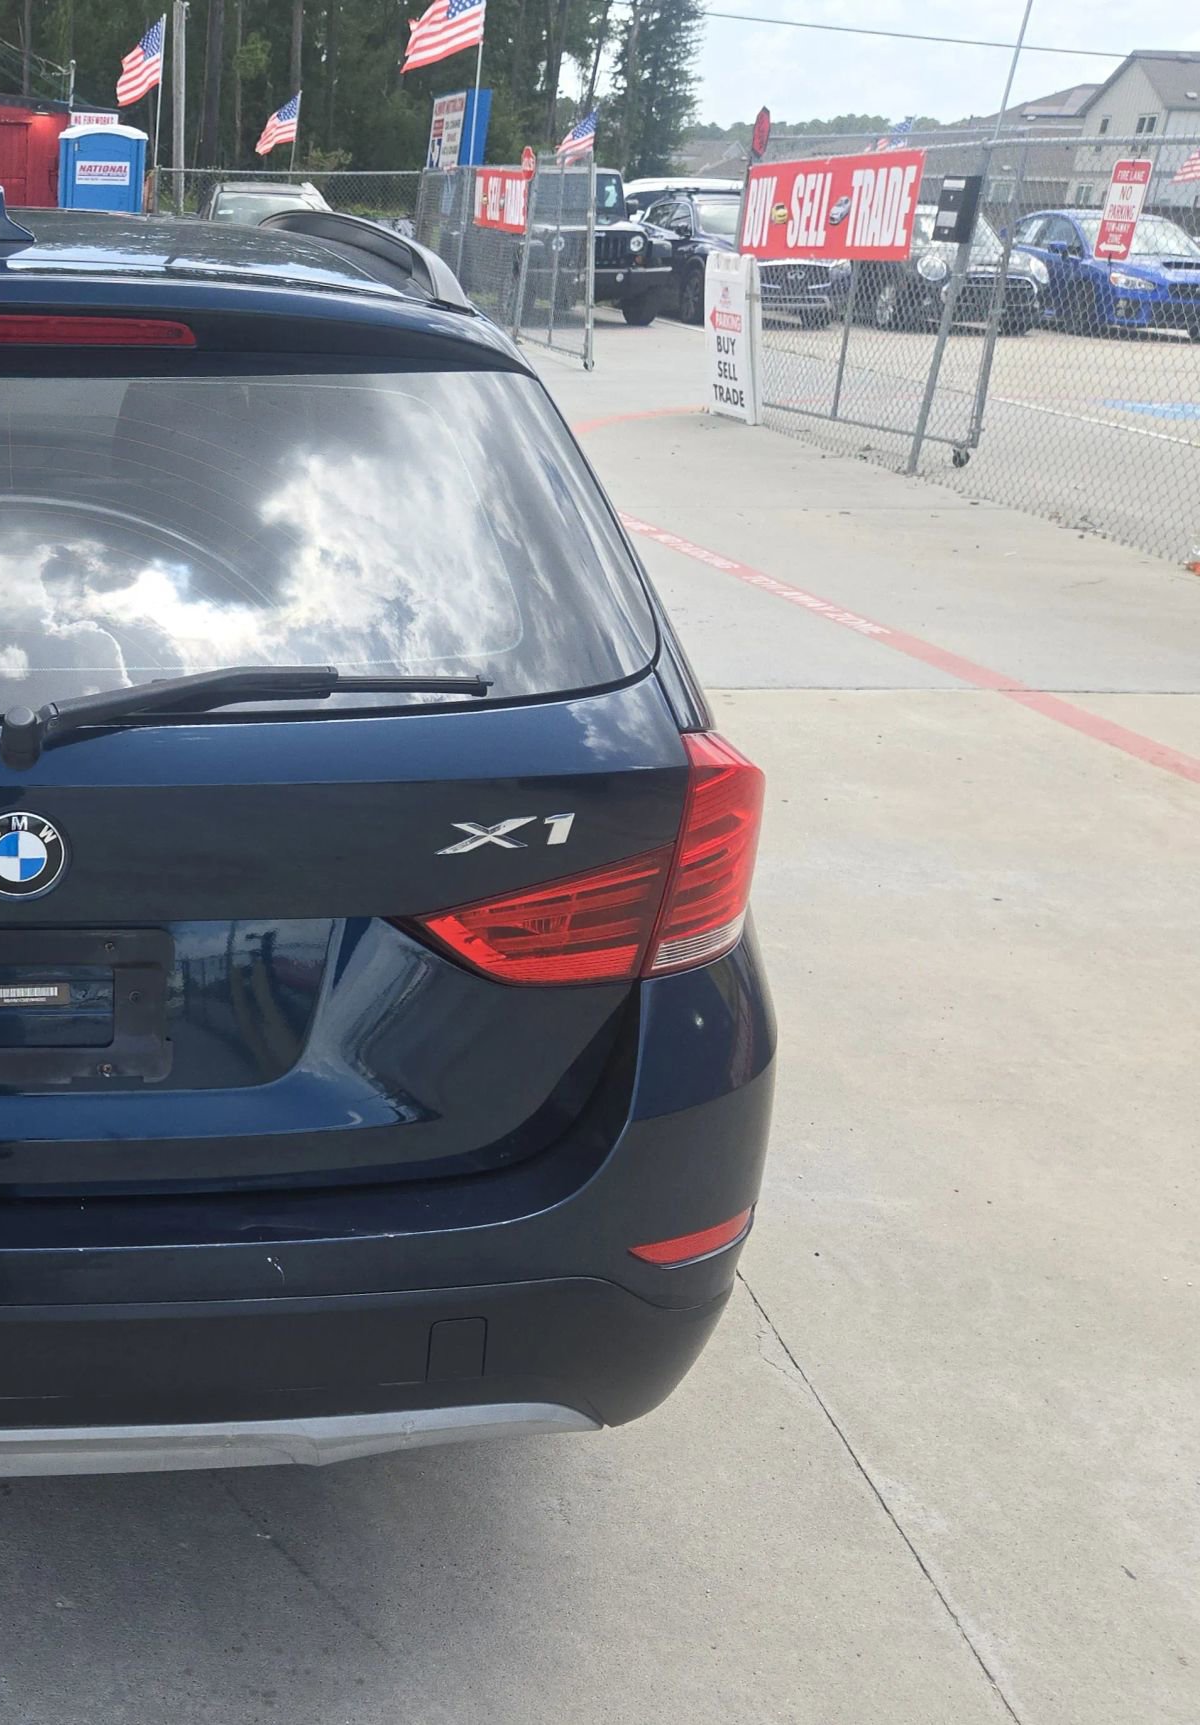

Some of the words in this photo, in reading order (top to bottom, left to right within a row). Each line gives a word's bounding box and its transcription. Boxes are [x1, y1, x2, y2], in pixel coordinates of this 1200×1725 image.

[79, 164, 128, 173] NATIONAL
[1117, 170, 1129, 181] FIRE
[1129, 170, 1145, 182] LANE
[1120, 186, 1133, 201] NO
[742, 177, 777, 248] BUY
[786, 172, 833, 248] SELL
[845, 165, 918, 248] TRADE
[1107, 203, 1135, 221] PARKING
[715, 312, 742, 332] PARKING
[716, 335, 736, 356] BUY
[717, 361, 738, 382] SELL
[713, 383, 745, 408] TRADE
[434, 812, 576, 855] X1
